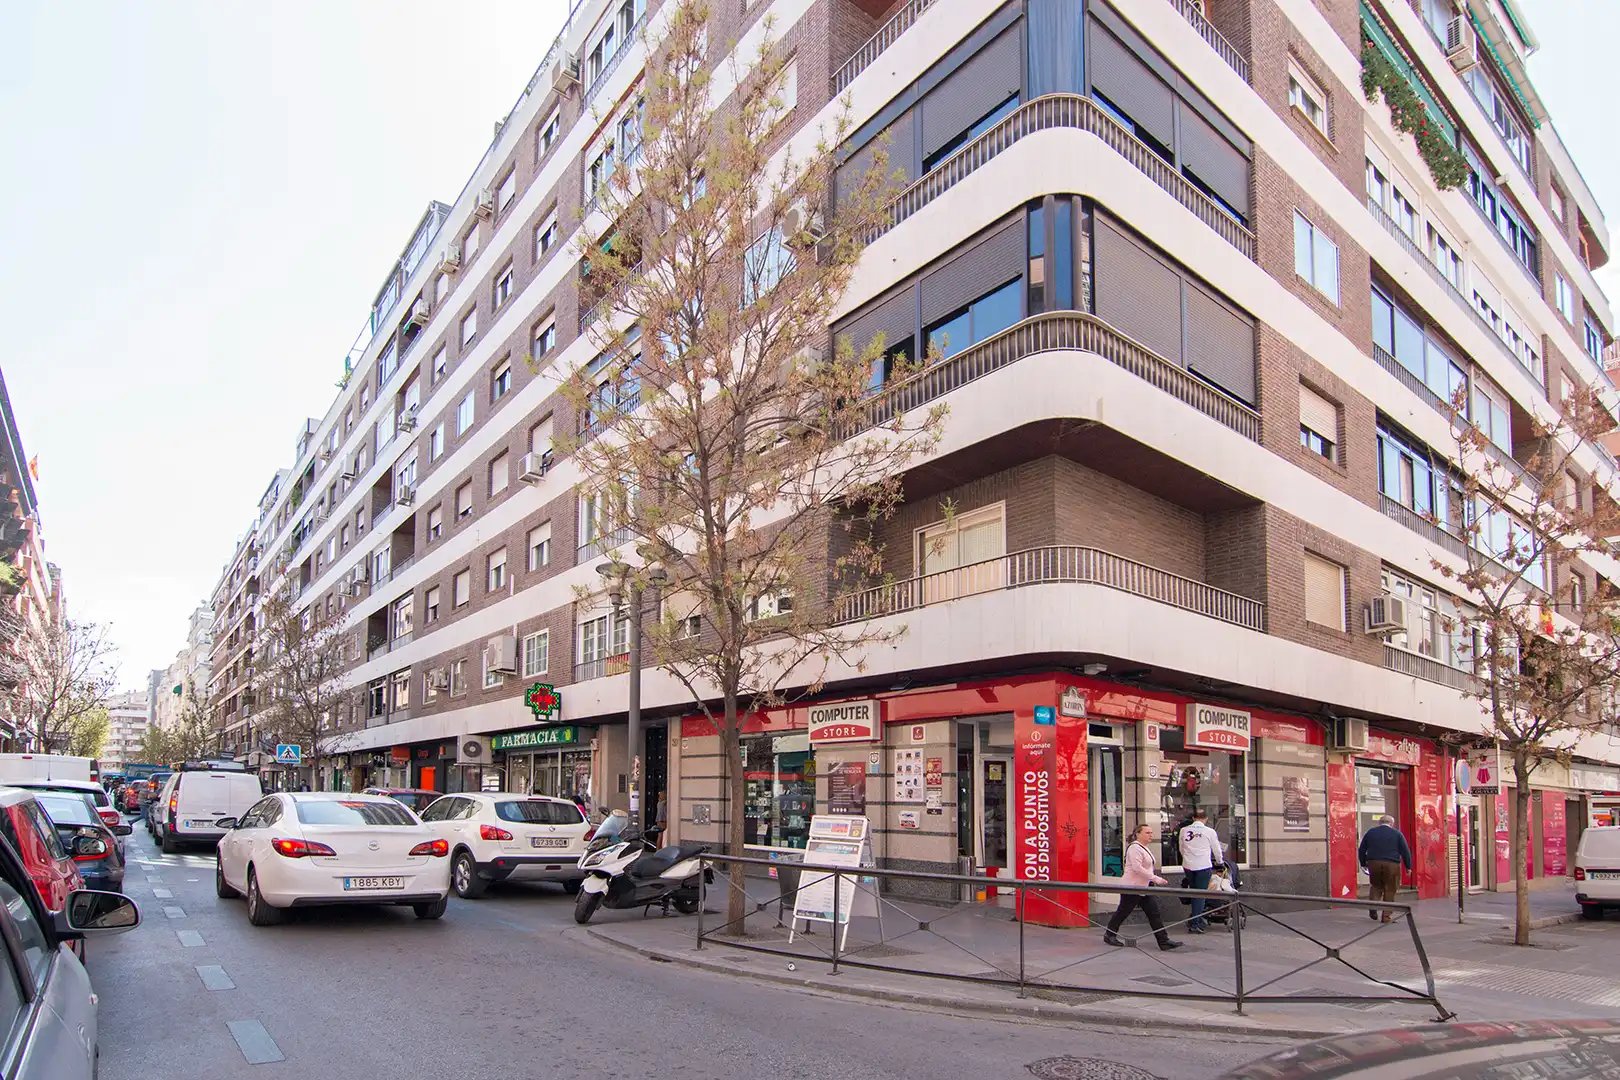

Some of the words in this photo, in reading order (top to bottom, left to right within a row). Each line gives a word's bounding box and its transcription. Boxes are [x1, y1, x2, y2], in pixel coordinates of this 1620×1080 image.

[811, 705, 869, 724] COMPUTER
[1198, 709, 1248, 731] COMPUTER
[501, 730, 557, 747] FARMACIA
[823, 727, 856, 738] STORE
[1209, 732, 1237, 745] STORE
[1024, 771, 1037, 830] PUNTO
[1037, 770, 1049, 863] DISPOSITIVOS
[1025, 836, 1037, 847] A
[1025, 853, 1037, 880] ON
[353, 878, 379, 887] 1885
[381, 877, 401, 887] KBY
